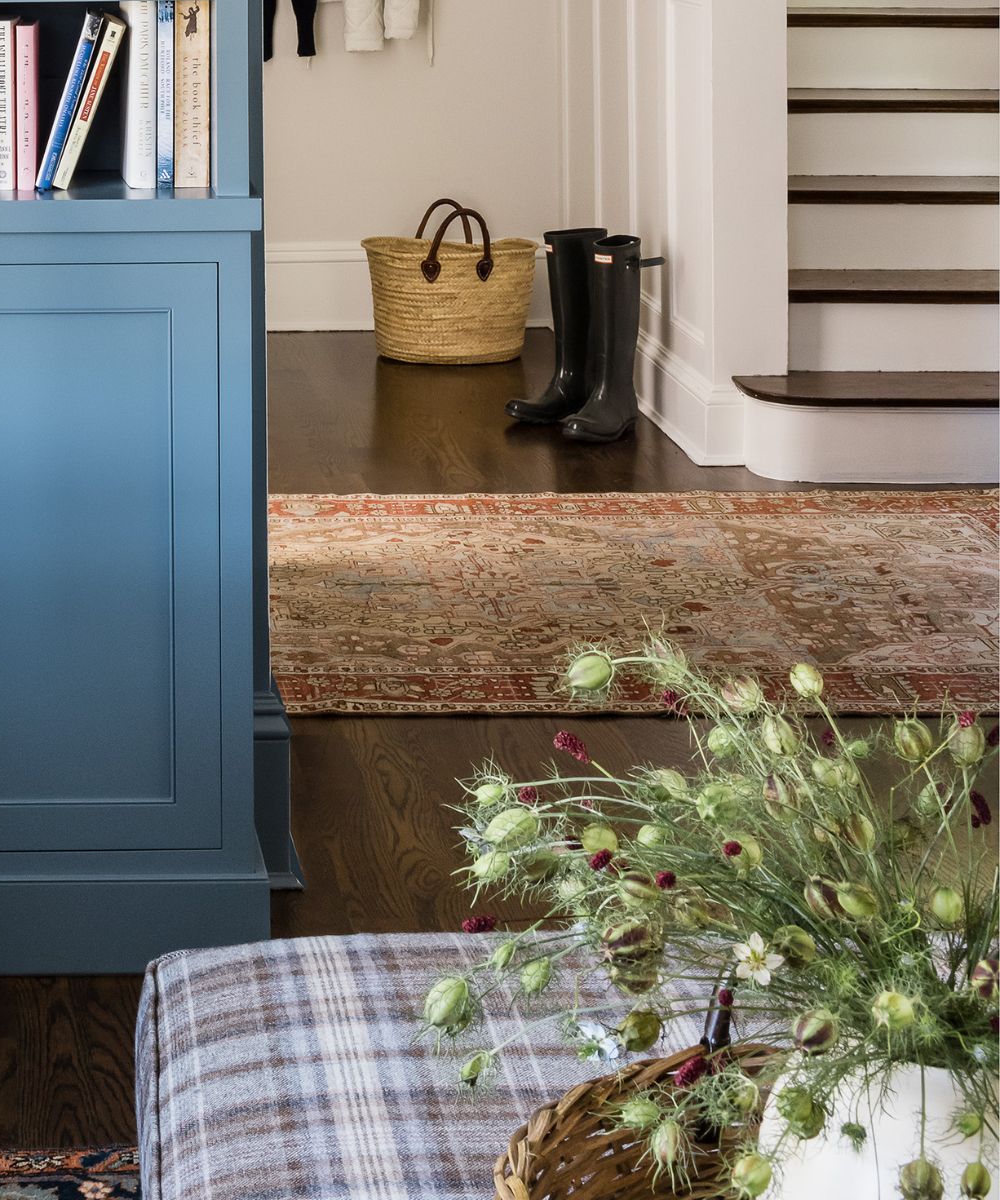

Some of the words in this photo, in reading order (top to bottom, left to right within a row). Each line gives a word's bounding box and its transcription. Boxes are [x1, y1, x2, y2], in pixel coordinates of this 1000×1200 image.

[192, 58, 200, 78] the
[192, 82, 201, 110] book
[192, 116, 201, 146] thief
